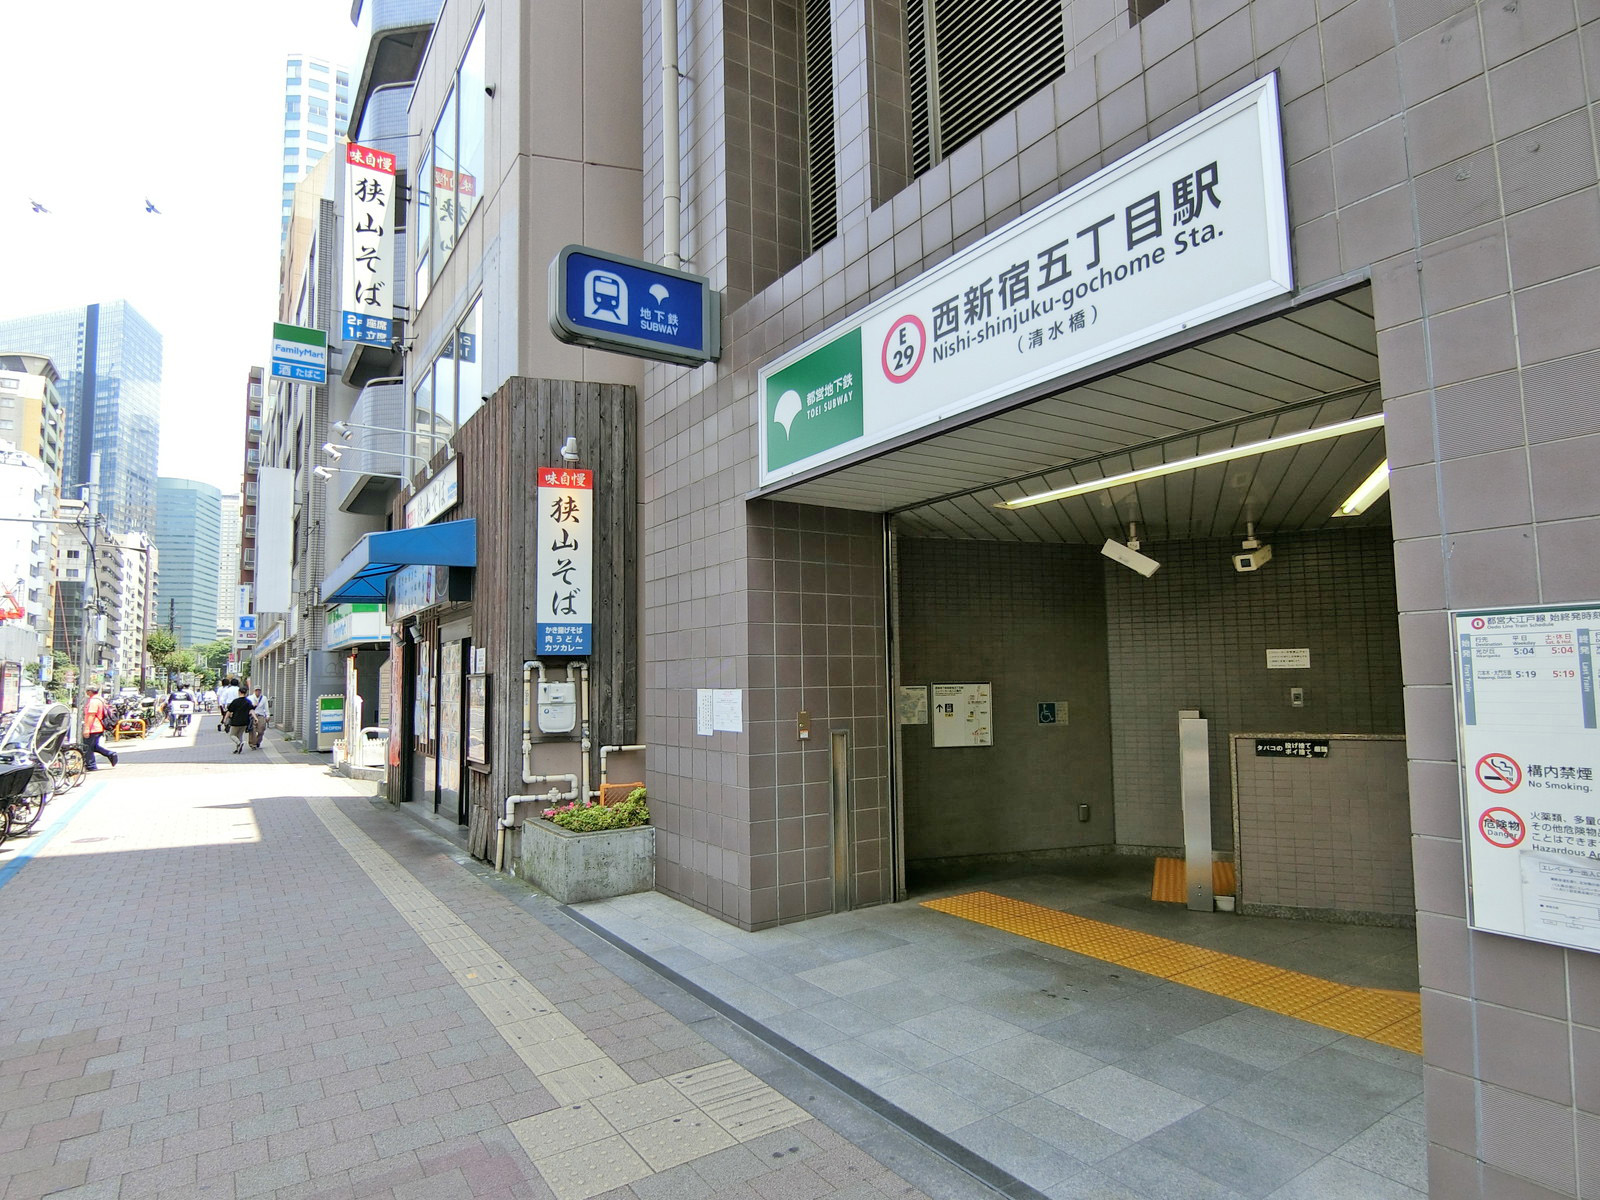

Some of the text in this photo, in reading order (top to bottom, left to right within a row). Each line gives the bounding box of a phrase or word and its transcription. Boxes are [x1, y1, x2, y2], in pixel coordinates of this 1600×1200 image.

[349, 148, 393, 172] 味自慢
[354, 176, 387, 307] 狭山そば
[932, 160, 1222, 343] 西新宿五丁目駅
[933, 221, 1224, 364] Nishi-shinjuku-gochome Sta.
[346, 314, 363, 326] 2F
[639, 306, 679, 326] 地下鉄
[348, 326, 363, 338] 1F
[640, 319, 679, 336] SUBWAY
[1017, 304, 1098, 354] （清水橋）
[899, 326, 907, 346] E
[275, 343, 325, 359] FamilyMart
[893, 344, 915, 371] 29
[278, 364, 321, 380] 酒 たばこ
[806, 372, 853, 407] 都営地下鉄
[806, 390, 853, 420] TOEI SUBWAY
[545, 470, 586, 487] 味自慢
[550, 495, 580, 616] 狭山そば
[1487, 614, 1546, 625] 都営大江戸線
[545, 635, 583, 644] 肉うどん
[545, 644, 583, 652] カツカレー
[1514, 647, 1534, 655] 5:04
[1551, 646, 1574, 655] 5:04
[1515, 670, 1537, 679] 5:19
[1552, 670, 1575, 678] 5:19
[1527, 764, 1593, 781] 構内禁煙
[1528, 780, 1593, 794] No Smoking.
[1484, 818, 1520, 831] 危険物
[1487, 829, 1517, 839] Danger
[1532, 844, 1586, 857] Hazardous
